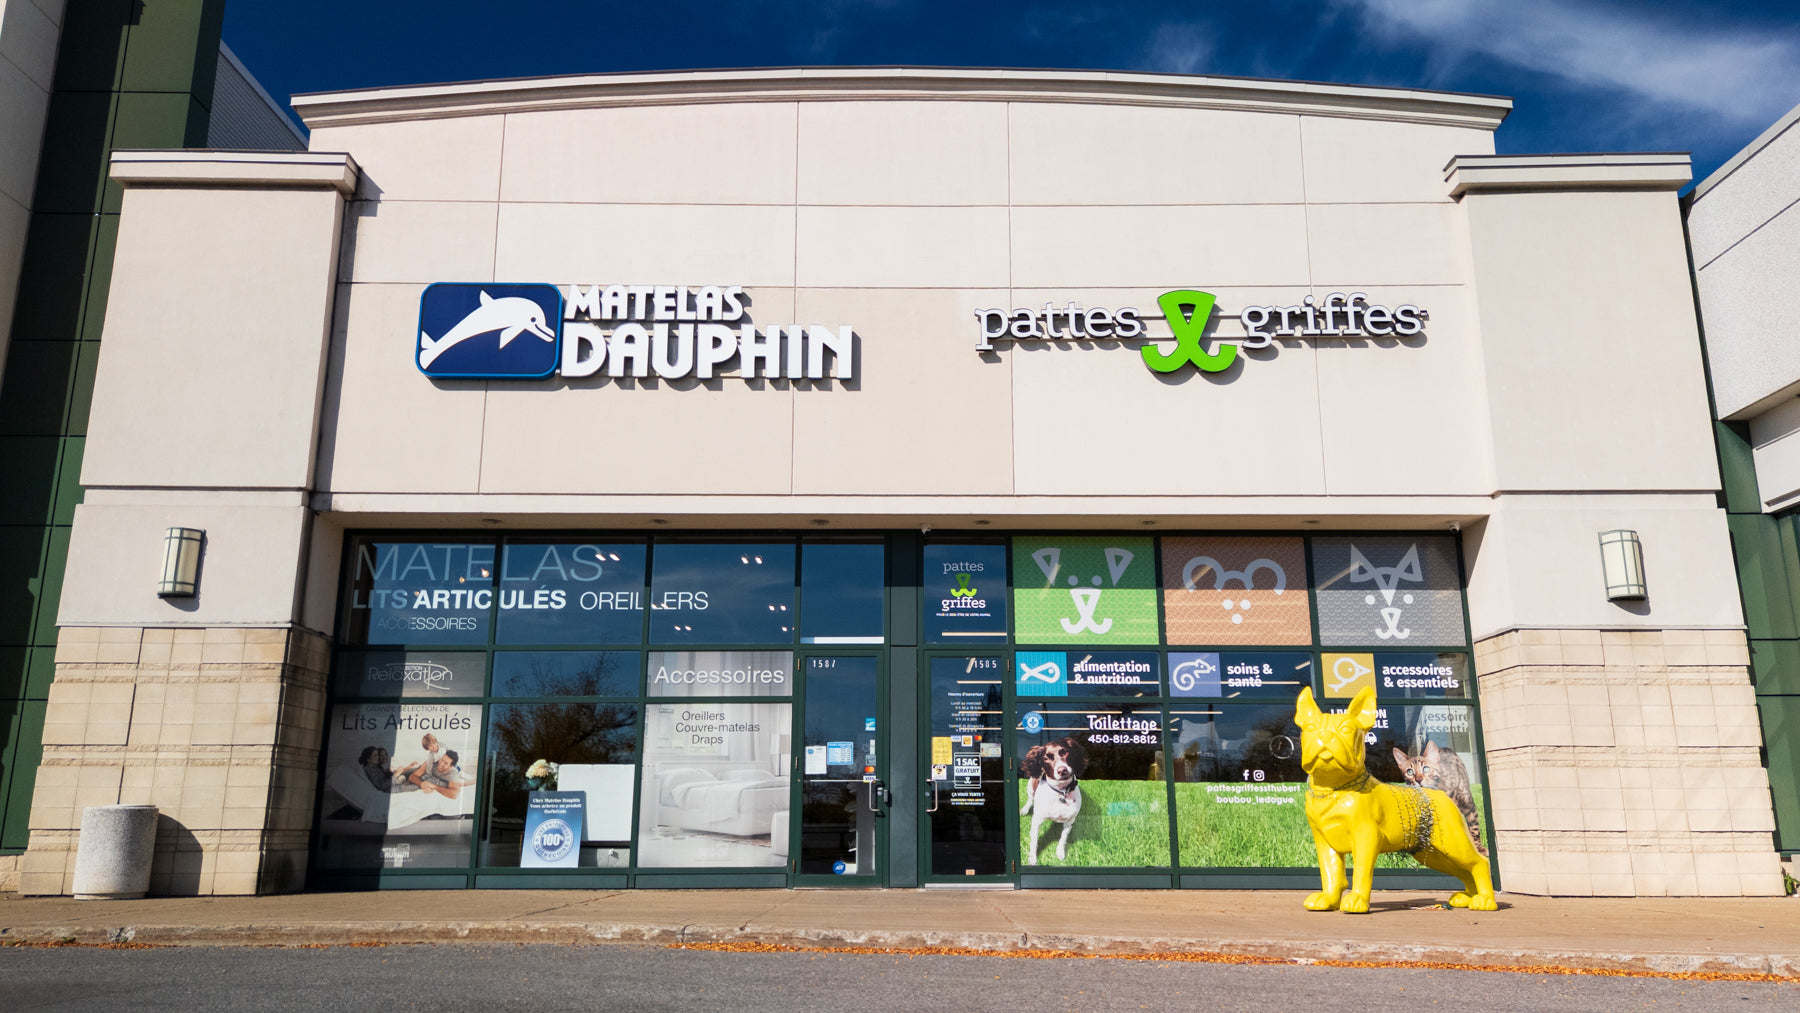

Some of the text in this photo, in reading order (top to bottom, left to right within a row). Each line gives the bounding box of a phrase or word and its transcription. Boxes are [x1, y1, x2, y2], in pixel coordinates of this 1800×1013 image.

[564, 285, 744, 321] MATELAS
[974, 292, 1422, 351] pattes griffes
[561, 322, 853, 379] DAUPHIN
[355, 544, 603, 581] MATELAS
[943, 562, 984, 574] pattes
[353, 589, 408, 609] LITS
[413, 585, 567, 610] ARTICULÉS
[941, 597, 986, 611] griffes
[974, 660, 997, 668] 1585
[1073, 661, 1150, 673] alimentation
[1227, 663, 1273, 675] soins &
[1382, 664, 1453, 676] accessoires
[654, 666, 785, 684] Accessoires
[1075, 673, 1140, 685] & nutrition
[1227, 675, 1262, 688] santé
[1384, 676, 1459, 689] & essentiels
[342, 712, 472, 730] Lits Articulés
[681, 710, 726, 721] Oreillers
[675, 722, 761, 733] Couvre-matelas
[1086, 714, 1158, 734] Toilettage
[691, 735, 724, 746] Draps
[1088, 734, 1158, 744] 450-812-8812
[956, 758, 978, 766] 1 SAC
